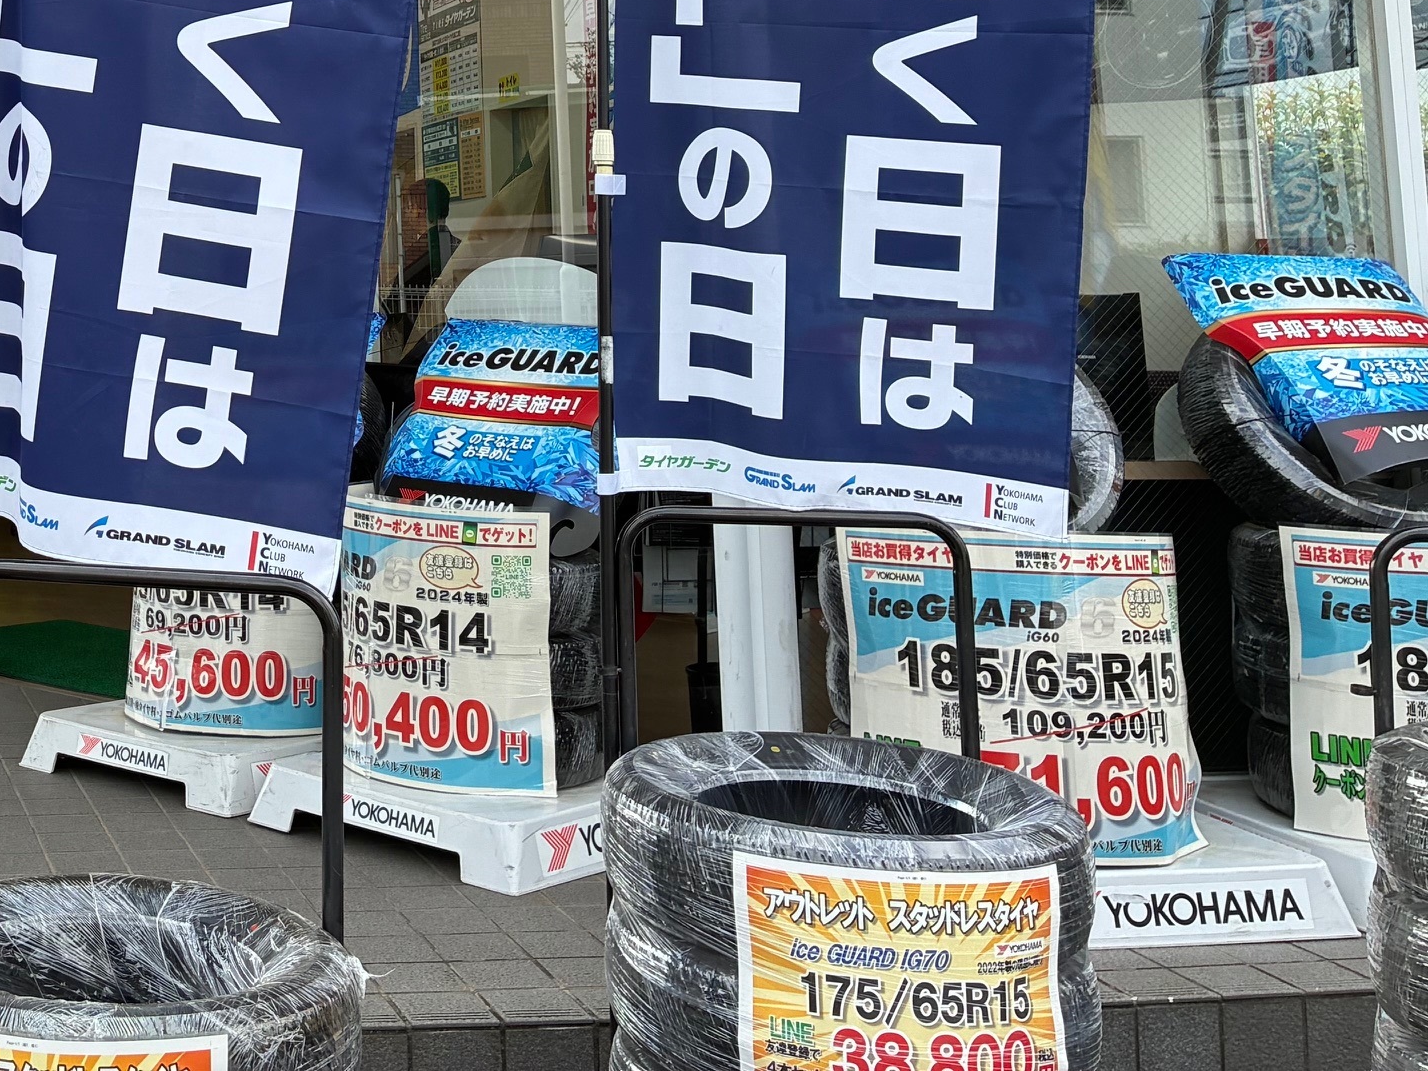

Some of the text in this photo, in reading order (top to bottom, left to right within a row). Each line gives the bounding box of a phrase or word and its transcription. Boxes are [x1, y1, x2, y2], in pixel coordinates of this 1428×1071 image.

[1209, 275, 1412, 306] iceGUARD
[1253, 317, 1428, 341] 早期予約実施中
[437, 342, 599, 376] iceGUARD
[427, 385, 582, 416] 早期予約実施中!
[462, 444, 517, 462] お早めに
[638, 454, 732, 474] タイヤガーデン
[743, 466, 816, 494] GRAND SLAM
[422, 492, 515, 513] YOKOHAMA
[855, 485, 911, 500] GRAND
[913, 489, 963, 505] SLAM
[995, 484, 1044, 504] YOKOHAMA
[995, 496, 1019, 512] CLUB
[993, 508, 1036, 527] NETWORK
[375, 516, 533, 544] クーポンを LINE でゲット!
[105, 529, 172, 547] GRAND
[173, 537, 226, 556] SLAM
[262, 531, 316, 555] YOKOHAMA
[850, 539, 955, 565] 当店お買得タイヤ
[261, 547, 286, 563] CLUB
[1014, 549, 1058, 561] 特別価格で
[1058, 551, 1122, 572] クーポンを
[1124, 554, 1150, 571] LINE
[1298, 543, 1424, 569] 当店お買得イヤ
[259, 559, 305, 580] NETWORK
[425, 566, 454, 581] こちら
[875, 570, 922, 584] YOKOHAMA
[1331, 575, 1369, 587] YOKOHA
[415, 587, 489, 606] 2024年製
[1026, 630, 1060, 643] iG60
[896, 638, 1178, 704] 185/65R15
[100, 740, 167, 772] YOKOHAMA
[351, 799, 436, 839] YOKOHAMA
[762, 887, 1041, 935] アウトレット スタッドレスタイヤ
[1103, 887, 1306, 930] YOKOHAMA
[790, 937, 820, 961] ice
[826, 942, 895, 970] GUARD
[1009, 939, 1043, 953] YOKOHAMA
[799, 970, 1034, 1027] 175/65R15
[769, 1015, 814, 1045] LINE
[830, 1028, 1037, 1071] 38800
